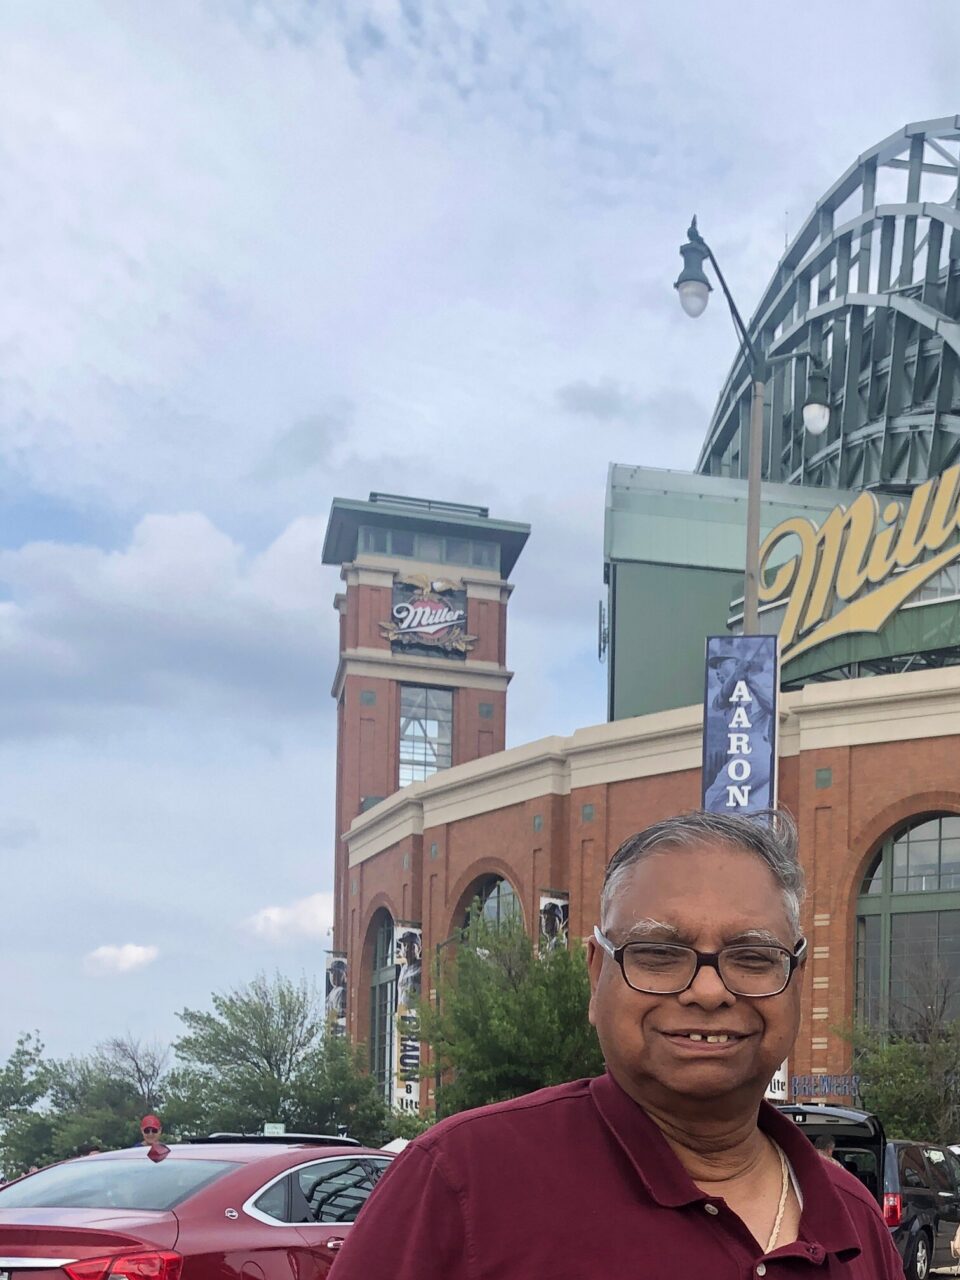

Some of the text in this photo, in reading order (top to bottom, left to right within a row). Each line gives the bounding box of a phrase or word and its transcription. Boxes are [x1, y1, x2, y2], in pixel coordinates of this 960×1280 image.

[393, 603, 464, 630] Miller
[726, 680, 752, 807] AARON
[405, 1083, 413, 1095] 8
[769, 1078, 787, 1095] Lite
[792, 1074, 861, 1097] BREWERS
